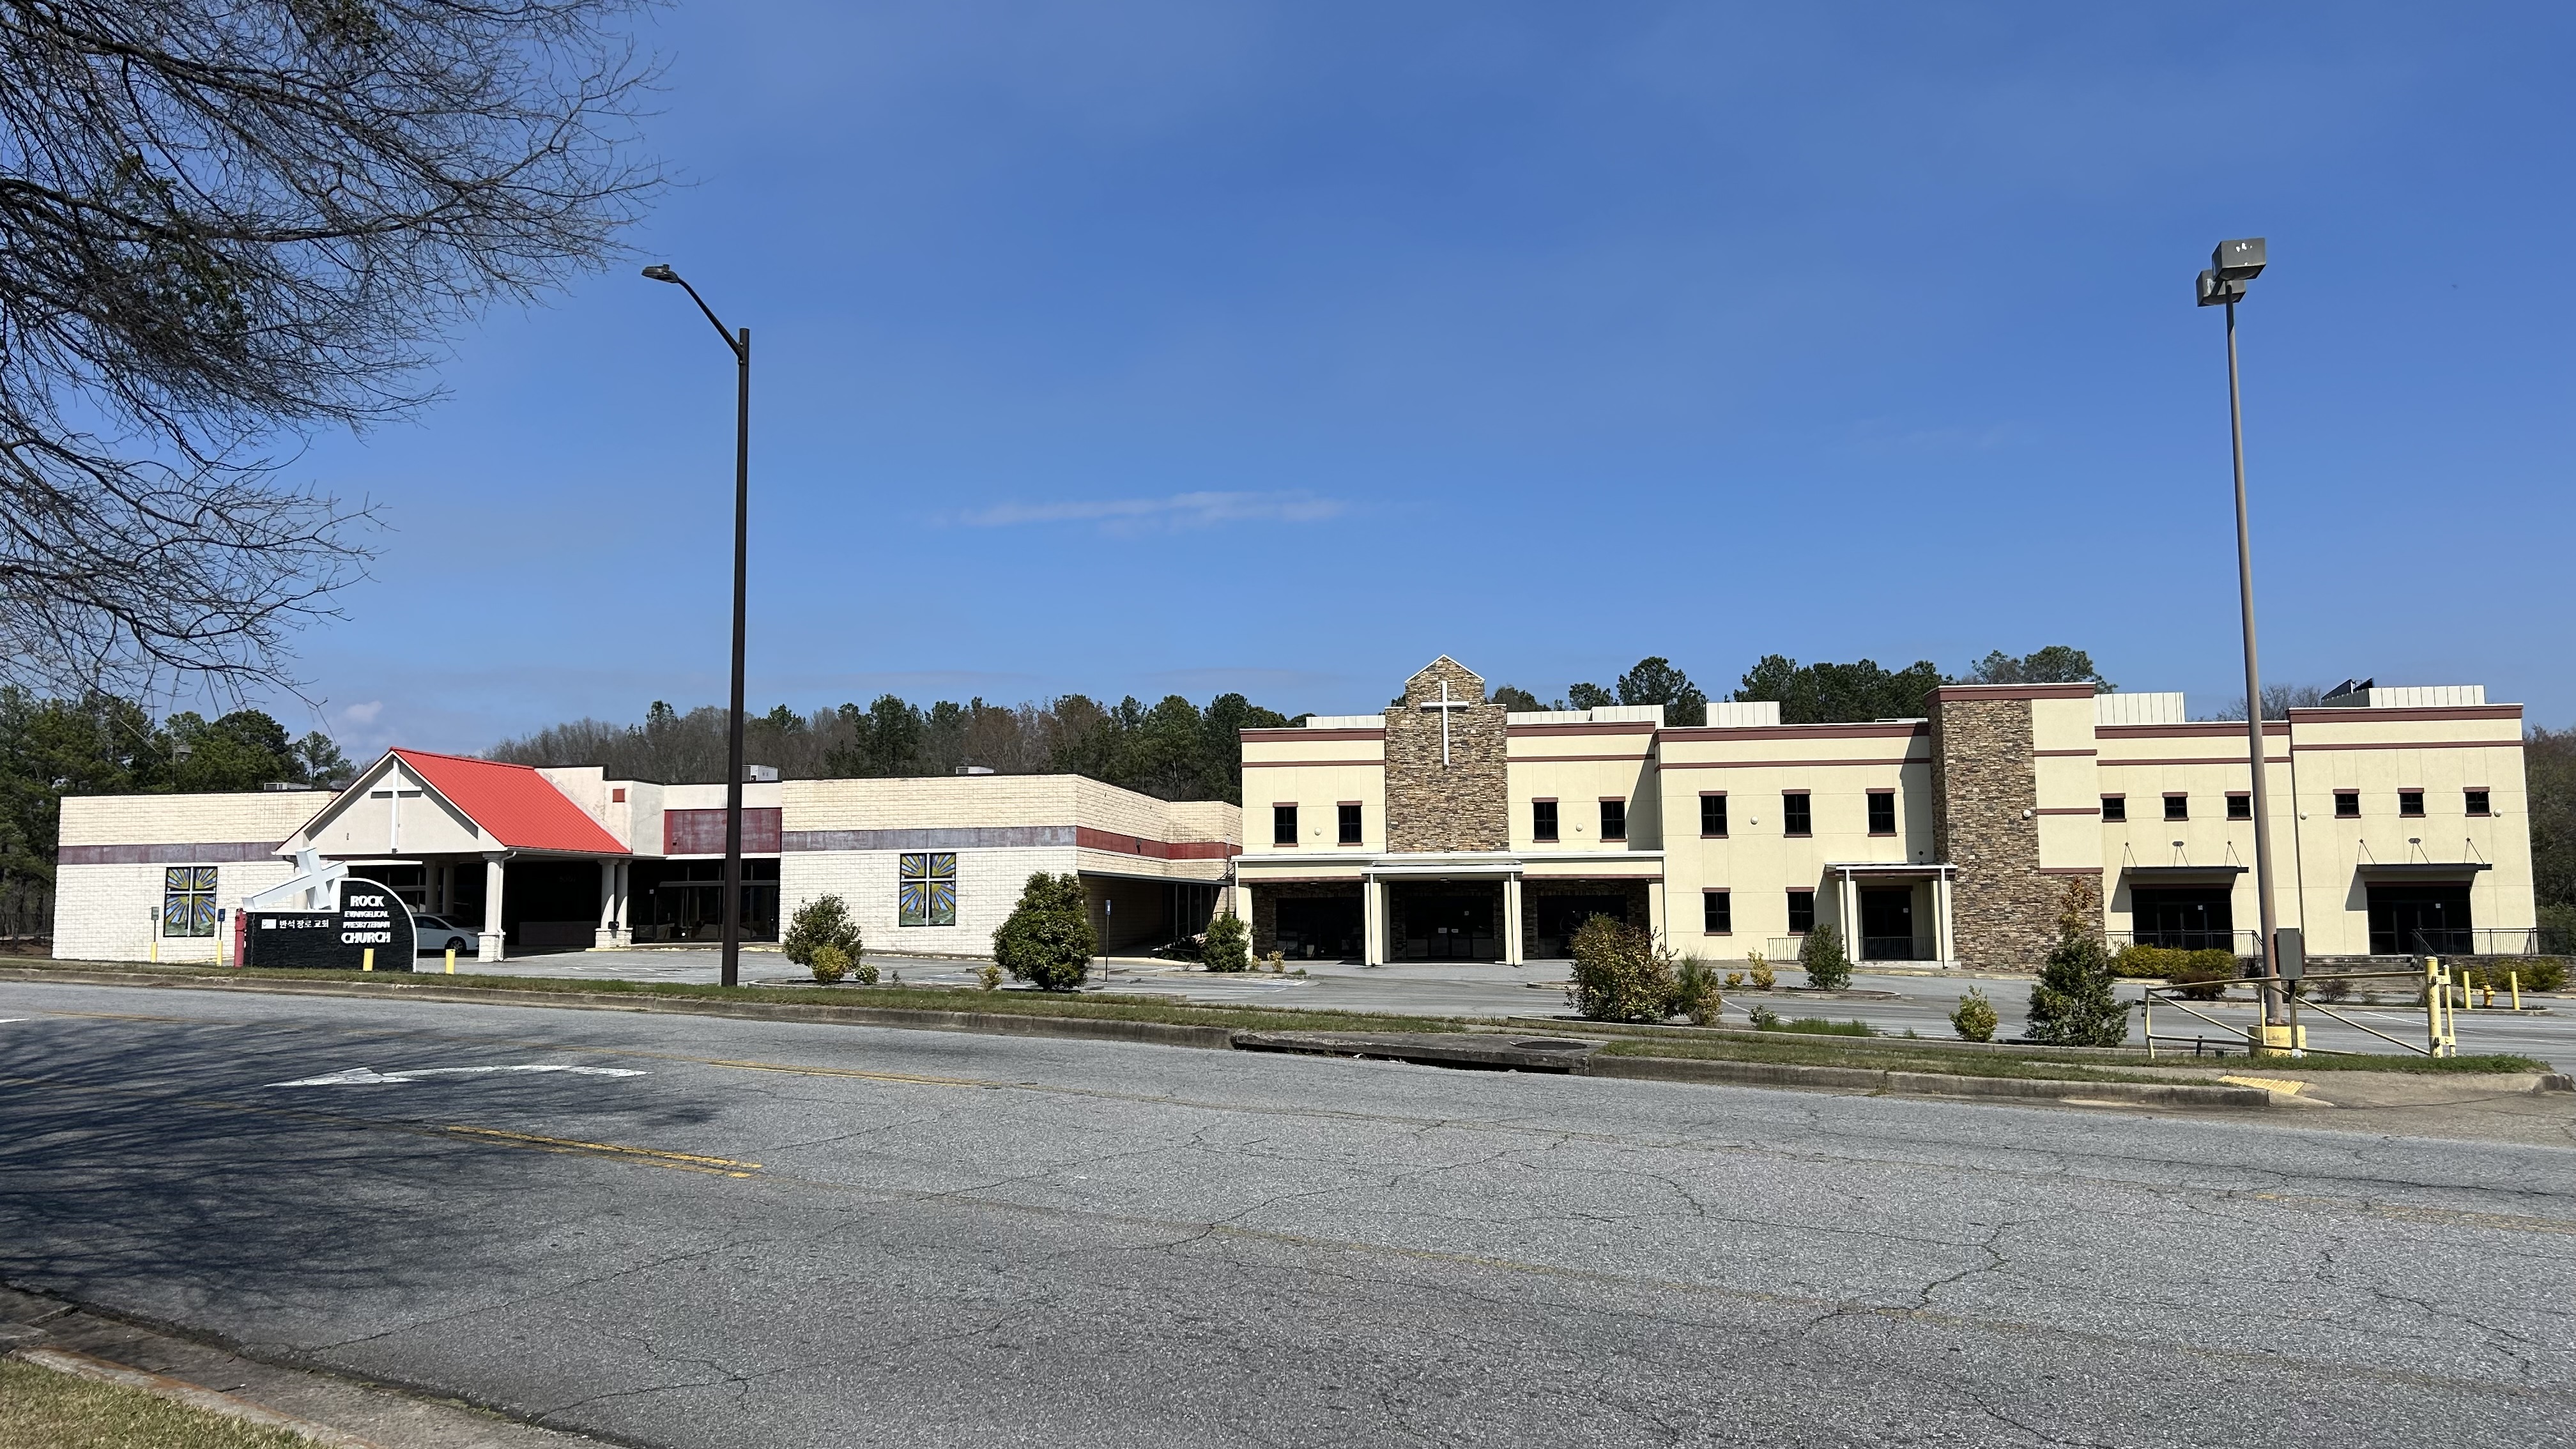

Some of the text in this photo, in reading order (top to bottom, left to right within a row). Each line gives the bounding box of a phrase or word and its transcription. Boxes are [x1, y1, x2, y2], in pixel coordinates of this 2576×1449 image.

[350, 895, 385, 907] ROCK
[279, 919, 329, 929] 반석 장로 교회
[341, 931, 391, 944] CHURCH
